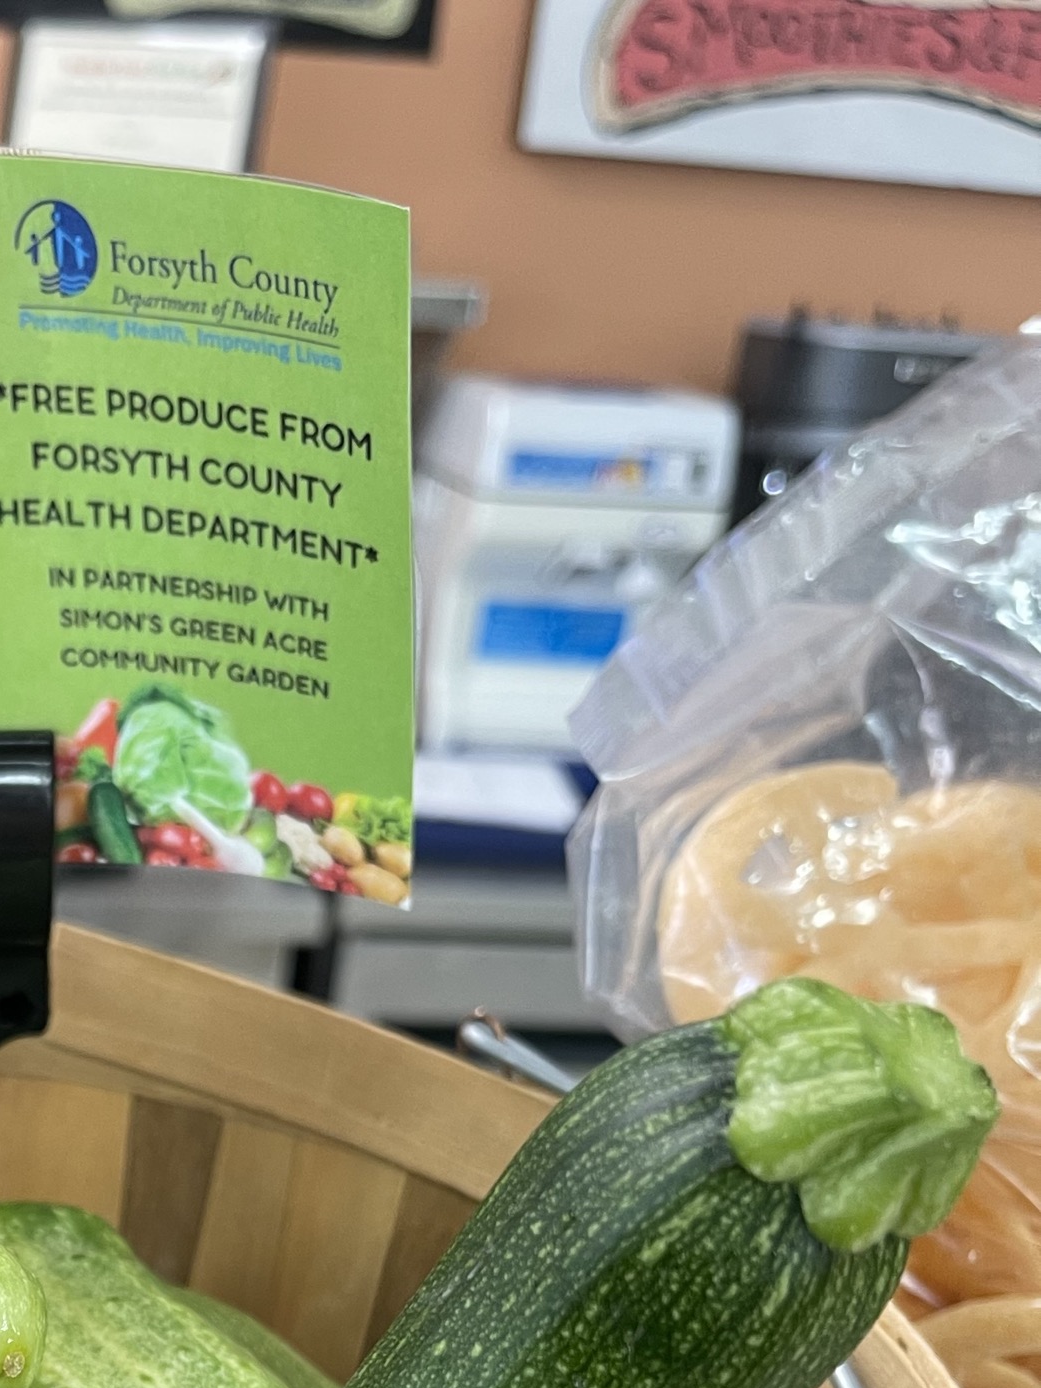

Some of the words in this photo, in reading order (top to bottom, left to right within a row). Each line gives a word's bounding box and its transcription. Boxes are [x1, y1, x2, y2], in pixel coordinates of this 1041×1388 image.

[110, 240, 218, 289] Forsyth
[228, 254, 339, 313] County
[111, 286, 208, 316] Department
[212, 301, 229, 324] of
[231, 302, 282, 327] Public
[286, 309, 340, 339] Health
[19, 311, 120, 341] Promoting
[196, 328, 291, 365] Improving
[296, 344, 343, 373] Lives
[106, 388, 270, 438] PRODUCE
[279, 412, 373, 461] FROM
[31, 441, 189, 482] FORSYTH
[200, 458, 343, 509] COUNTY
[48, 566, 76, 588] IN
[83, 568, 258, 606] PARTNERSHIP
[264, 590, 330, 621] WITH
[60, 608, 163, 635] SIMON'S
[169, 617, 256, 647] GREEN
[263, 632, 329, 662] ACRE
[61, 647, 221, 680] COMMUNITY
[227, 663, 330, 699] GARDEN
